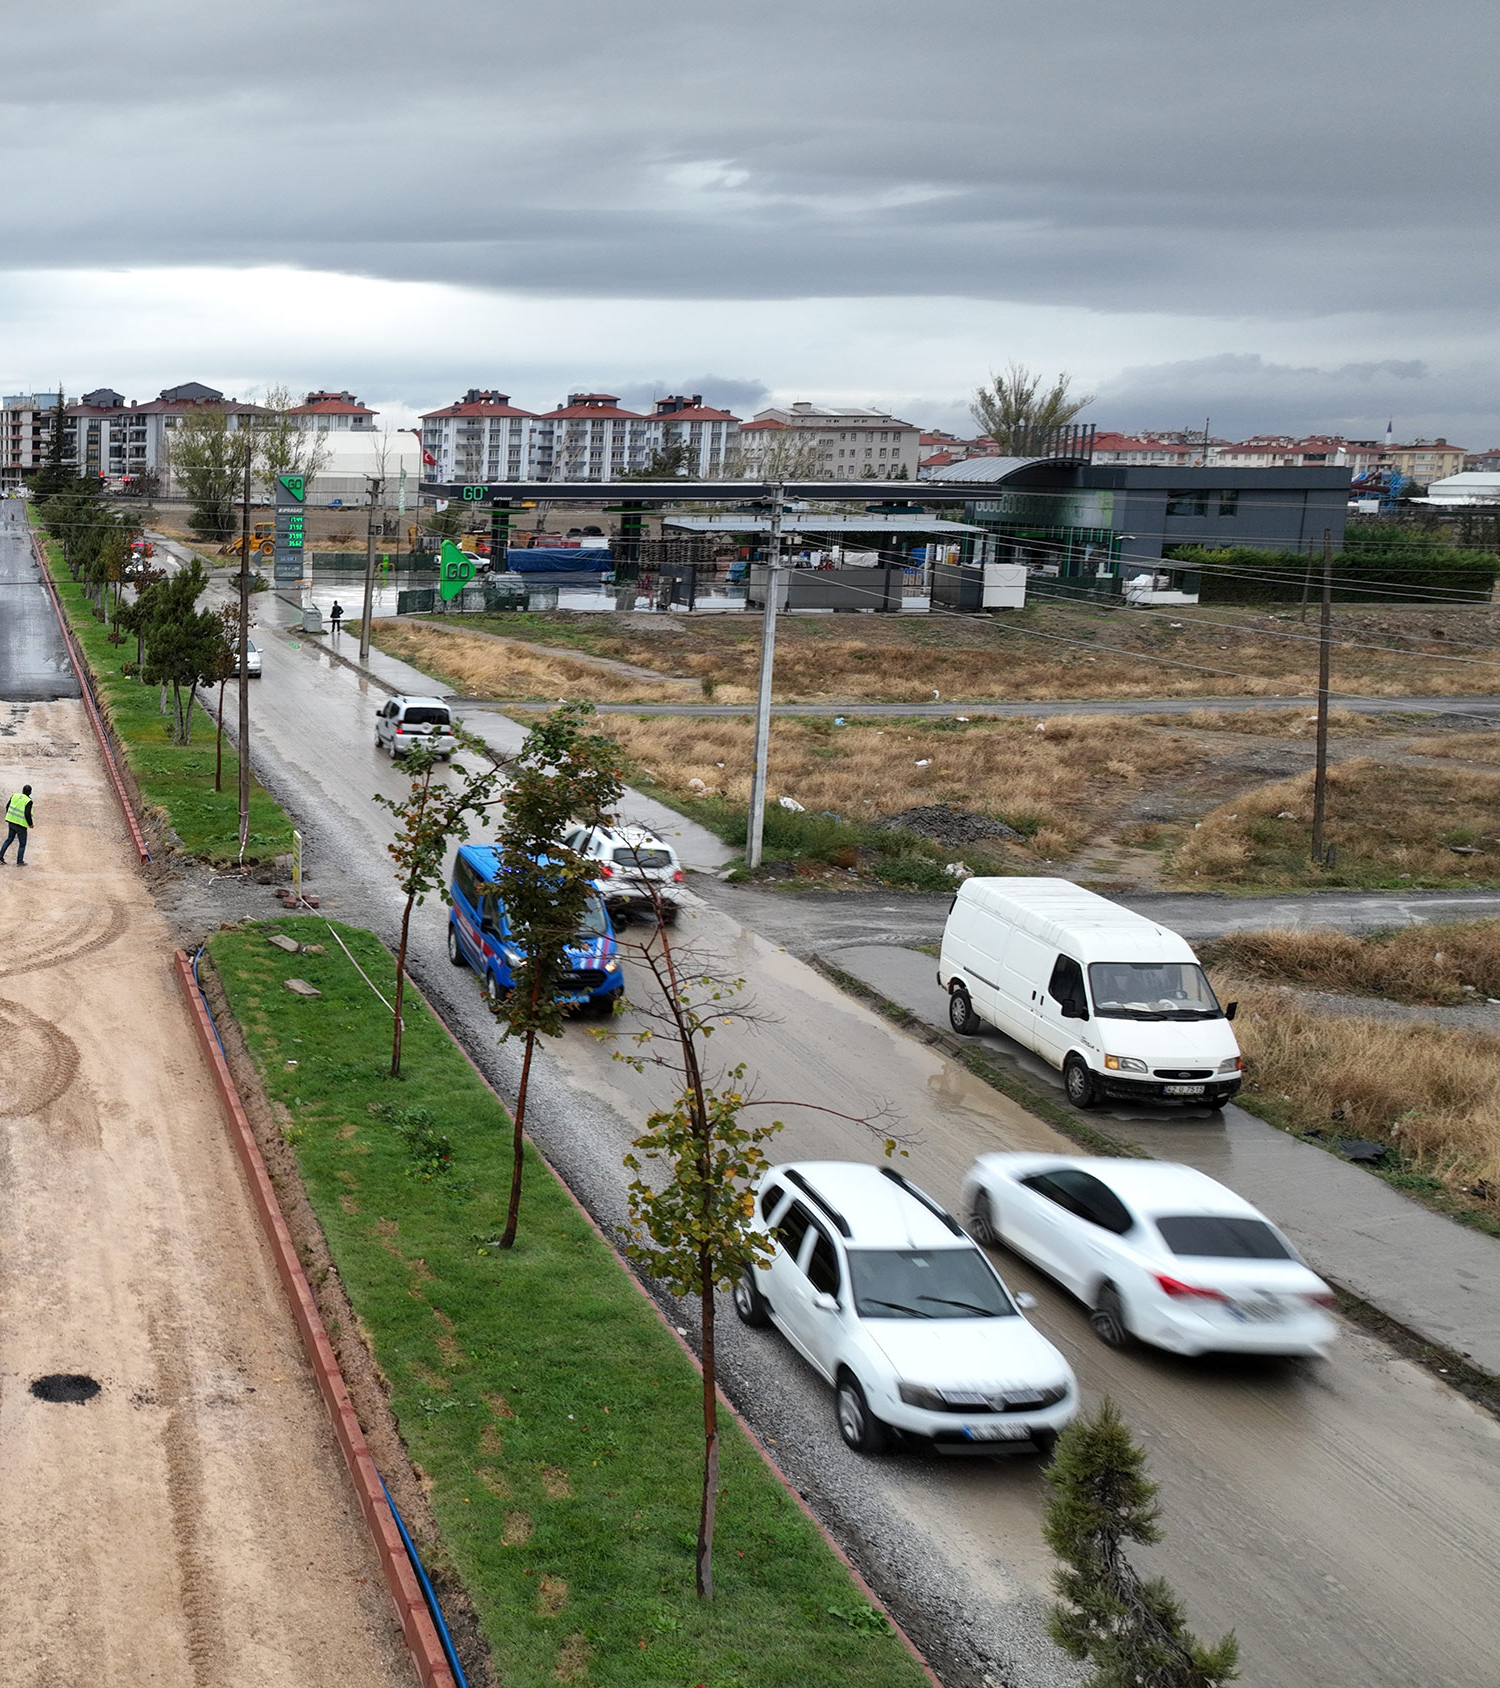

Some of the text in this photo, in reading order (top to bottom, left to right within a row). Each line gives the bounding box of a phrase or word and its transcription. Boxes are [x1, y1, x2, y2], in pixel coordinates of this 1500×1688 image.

[288, 479, 302, 489] GO
[463, 487, 483, 500] GO
[446, 562, 469, 579] GO
